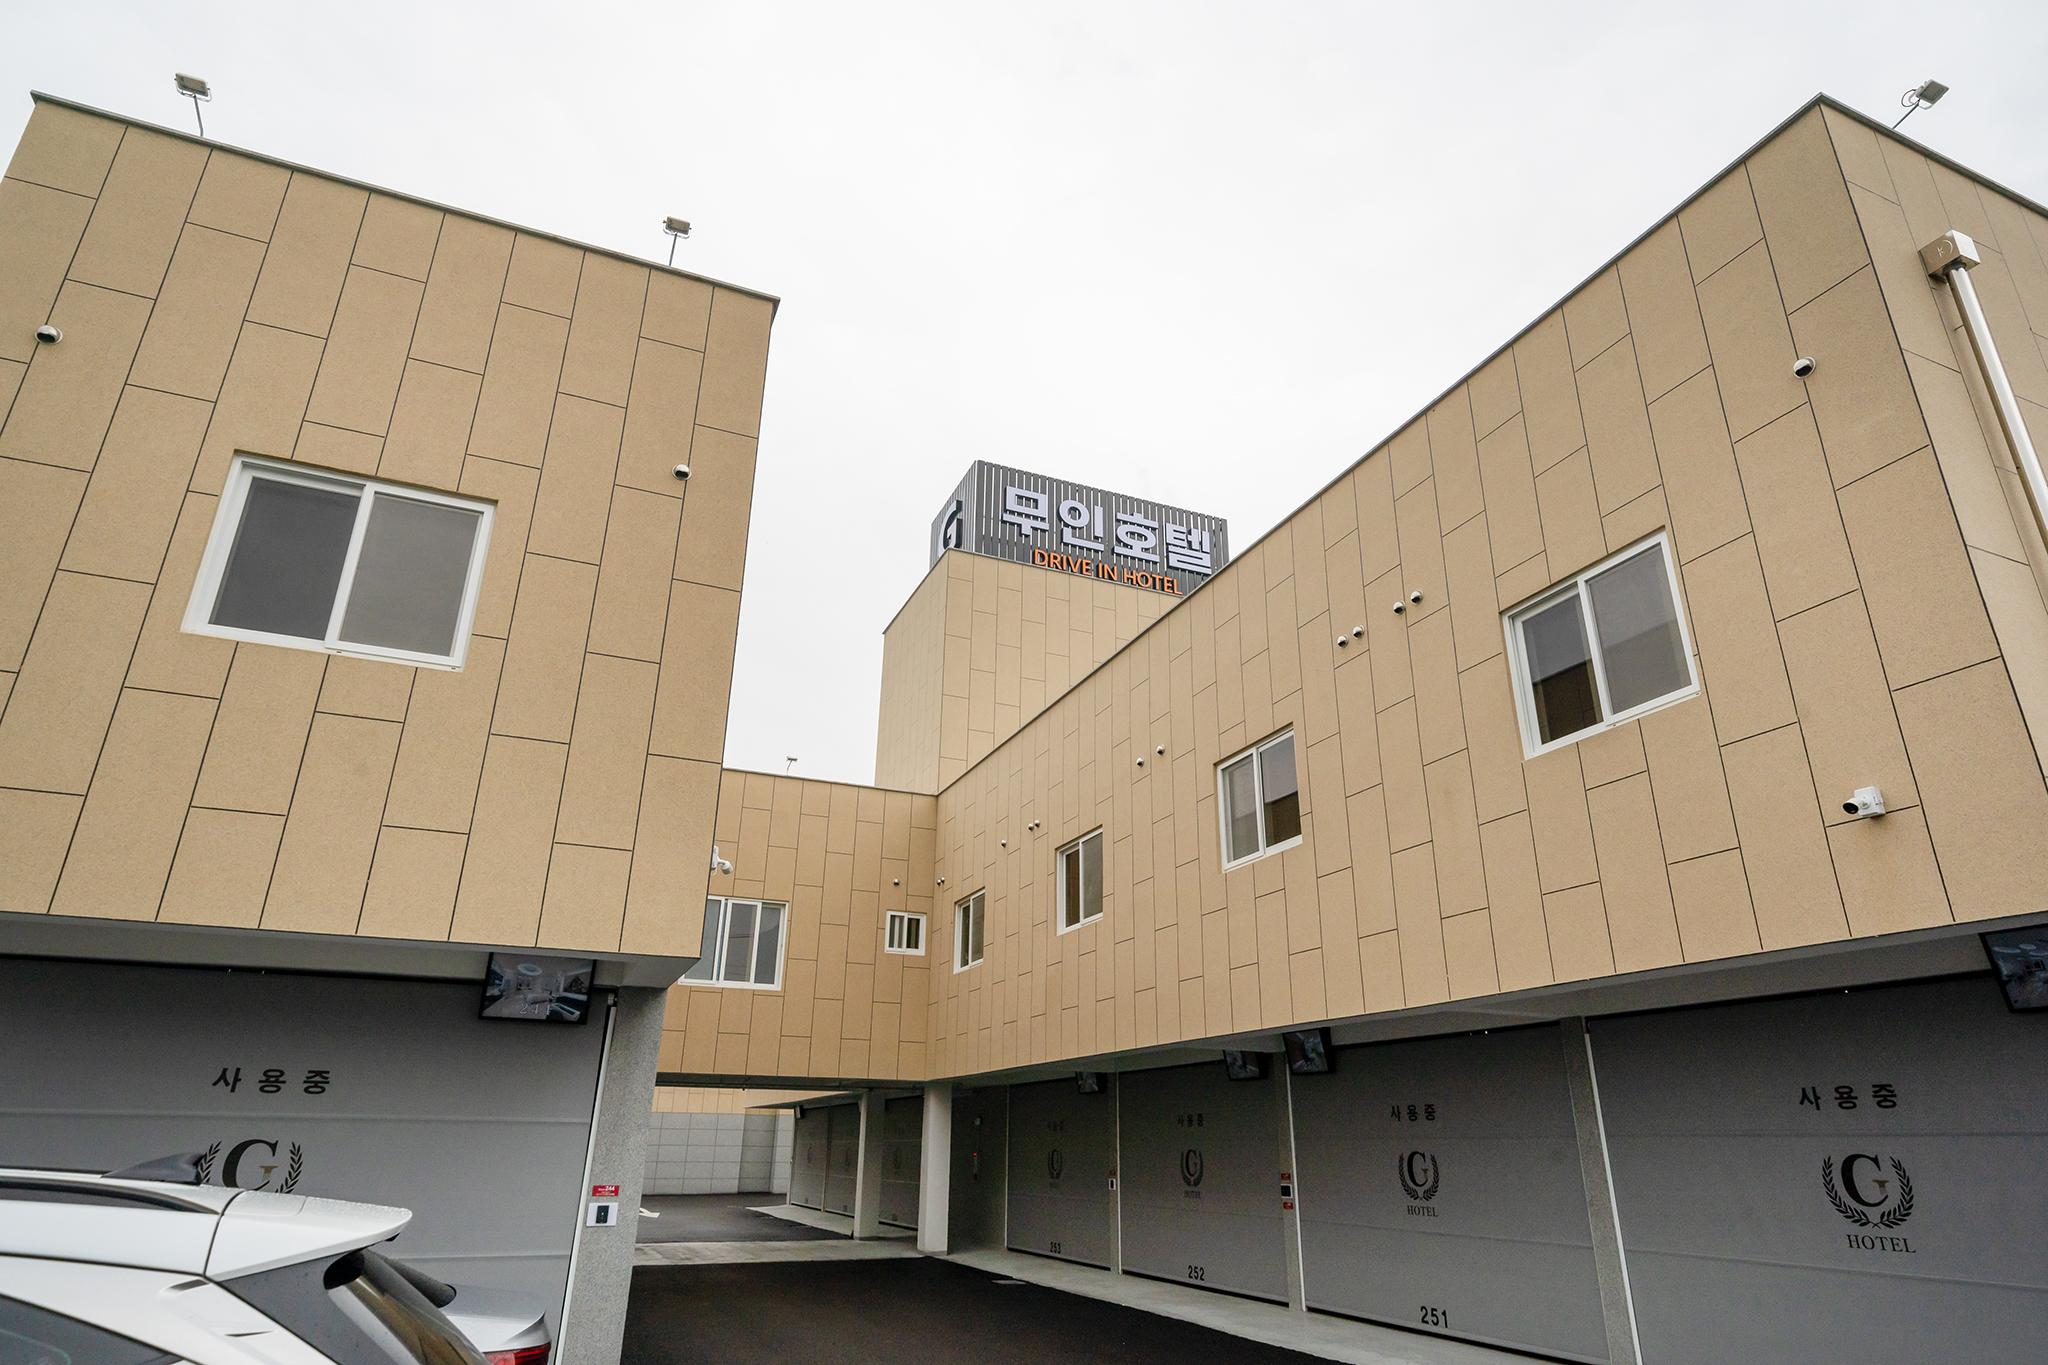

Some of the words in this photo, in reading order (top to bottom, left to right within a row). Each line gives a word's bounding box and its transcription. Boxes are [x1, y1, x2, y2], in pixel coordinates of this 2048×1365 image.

[1002, 485, 1212, 575] 무인호텔
[1034, 549, 1092, 576] DRIVE
[1097, 560, 1118, 581] IN
[1123, 568, 1184, 596] HOTEL
[1407, 1205, 1438, 1217] HOTEL
[1846, 1234, 1917, 1254] HOTEL
[1187, 1265, 1205, 1281] 252
[1420, 1305, 1448, 1329] 251
